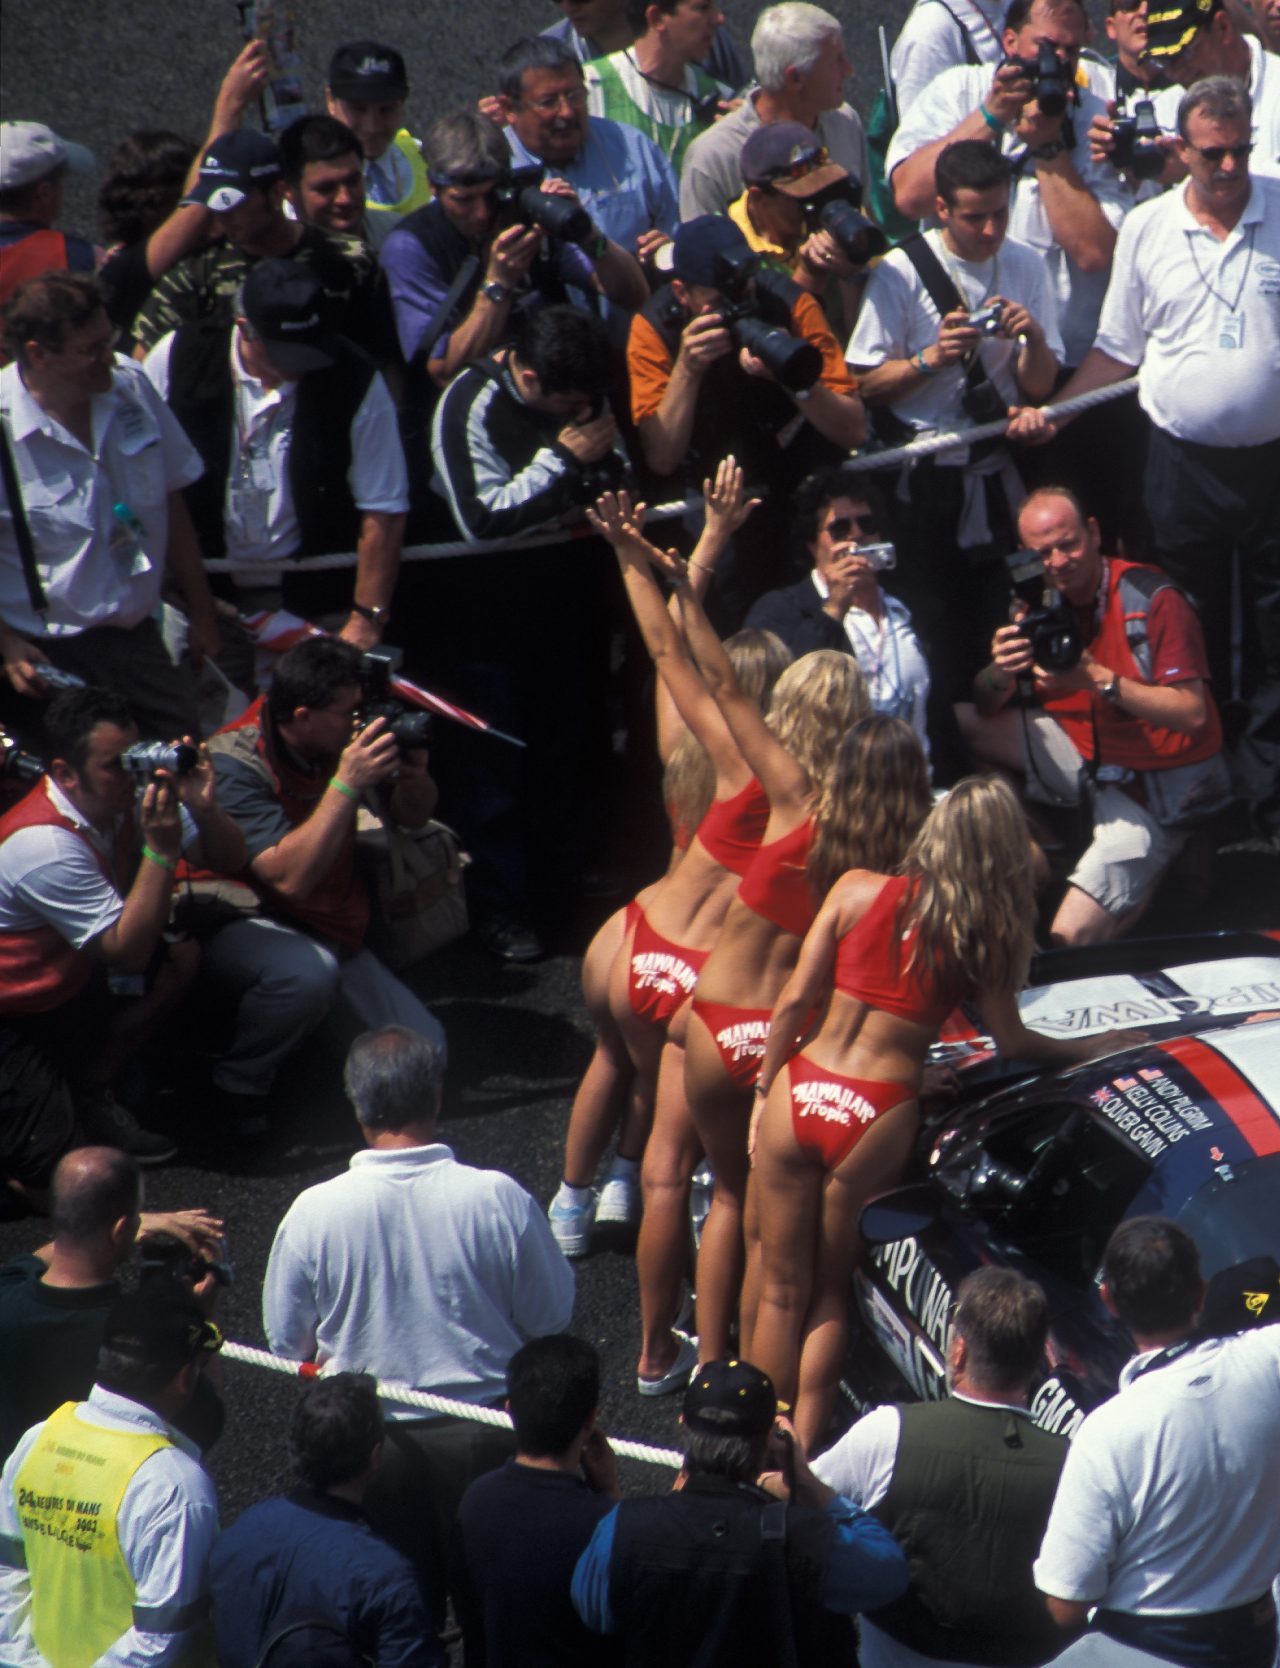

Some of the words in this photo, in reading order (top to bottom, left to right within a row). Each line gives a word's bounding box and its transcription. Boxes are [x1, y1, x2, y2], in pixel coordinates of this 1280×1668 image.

[632, 952, 698, 994] HAWAIIAN
[717, 1021, 771, 1049] HAWAI
[730, 1039, 767, 1061] Trop
[792, 1082, 876, 1124] HAWAIIAN
[1124, 1085, 1158, 1109] KELLY
[1144, 1104, 1190, 1142] COLLINS
[1150, 1078, 1184, 1100] ANDY
[1168, 1096, 1214, 1131] PILGRIM
[1102, 1097, 1141, 1132] OLIVER
[1130, 1123, 1168, 1158] GAVIN
[75, 1502, 102, 1516] MANS
